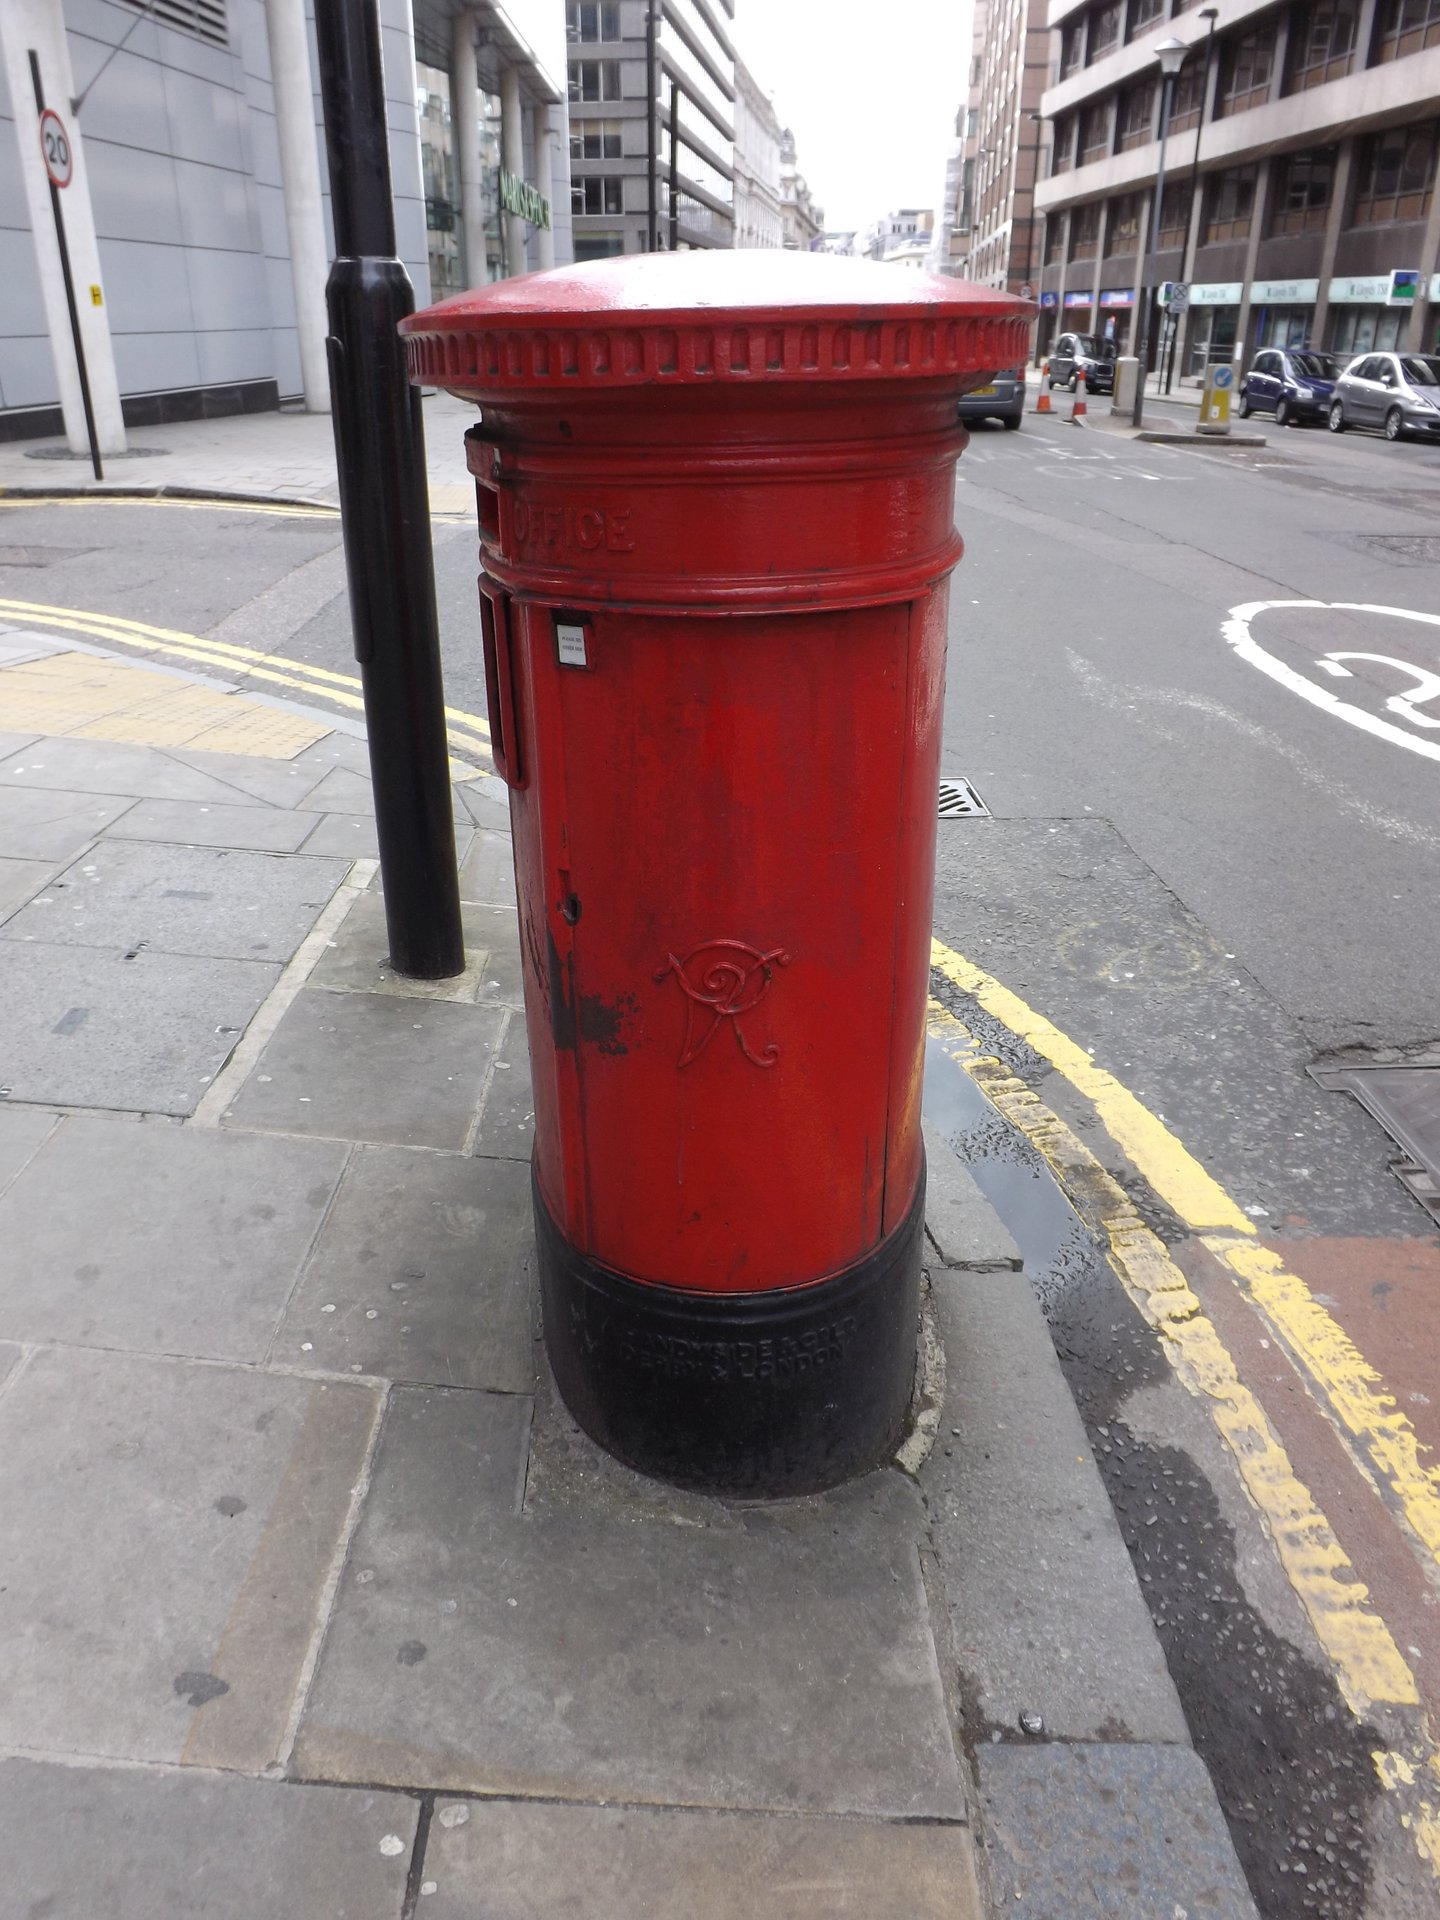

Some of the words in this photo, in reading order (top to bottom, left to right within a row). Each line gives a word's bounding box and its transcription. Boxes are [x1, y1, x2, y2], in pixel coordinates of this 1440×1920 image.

[45, 132, 69, 166] 20
[514, 501, 635, 552] OFFICE
[739, 1343, 845, 1379] LONDON
